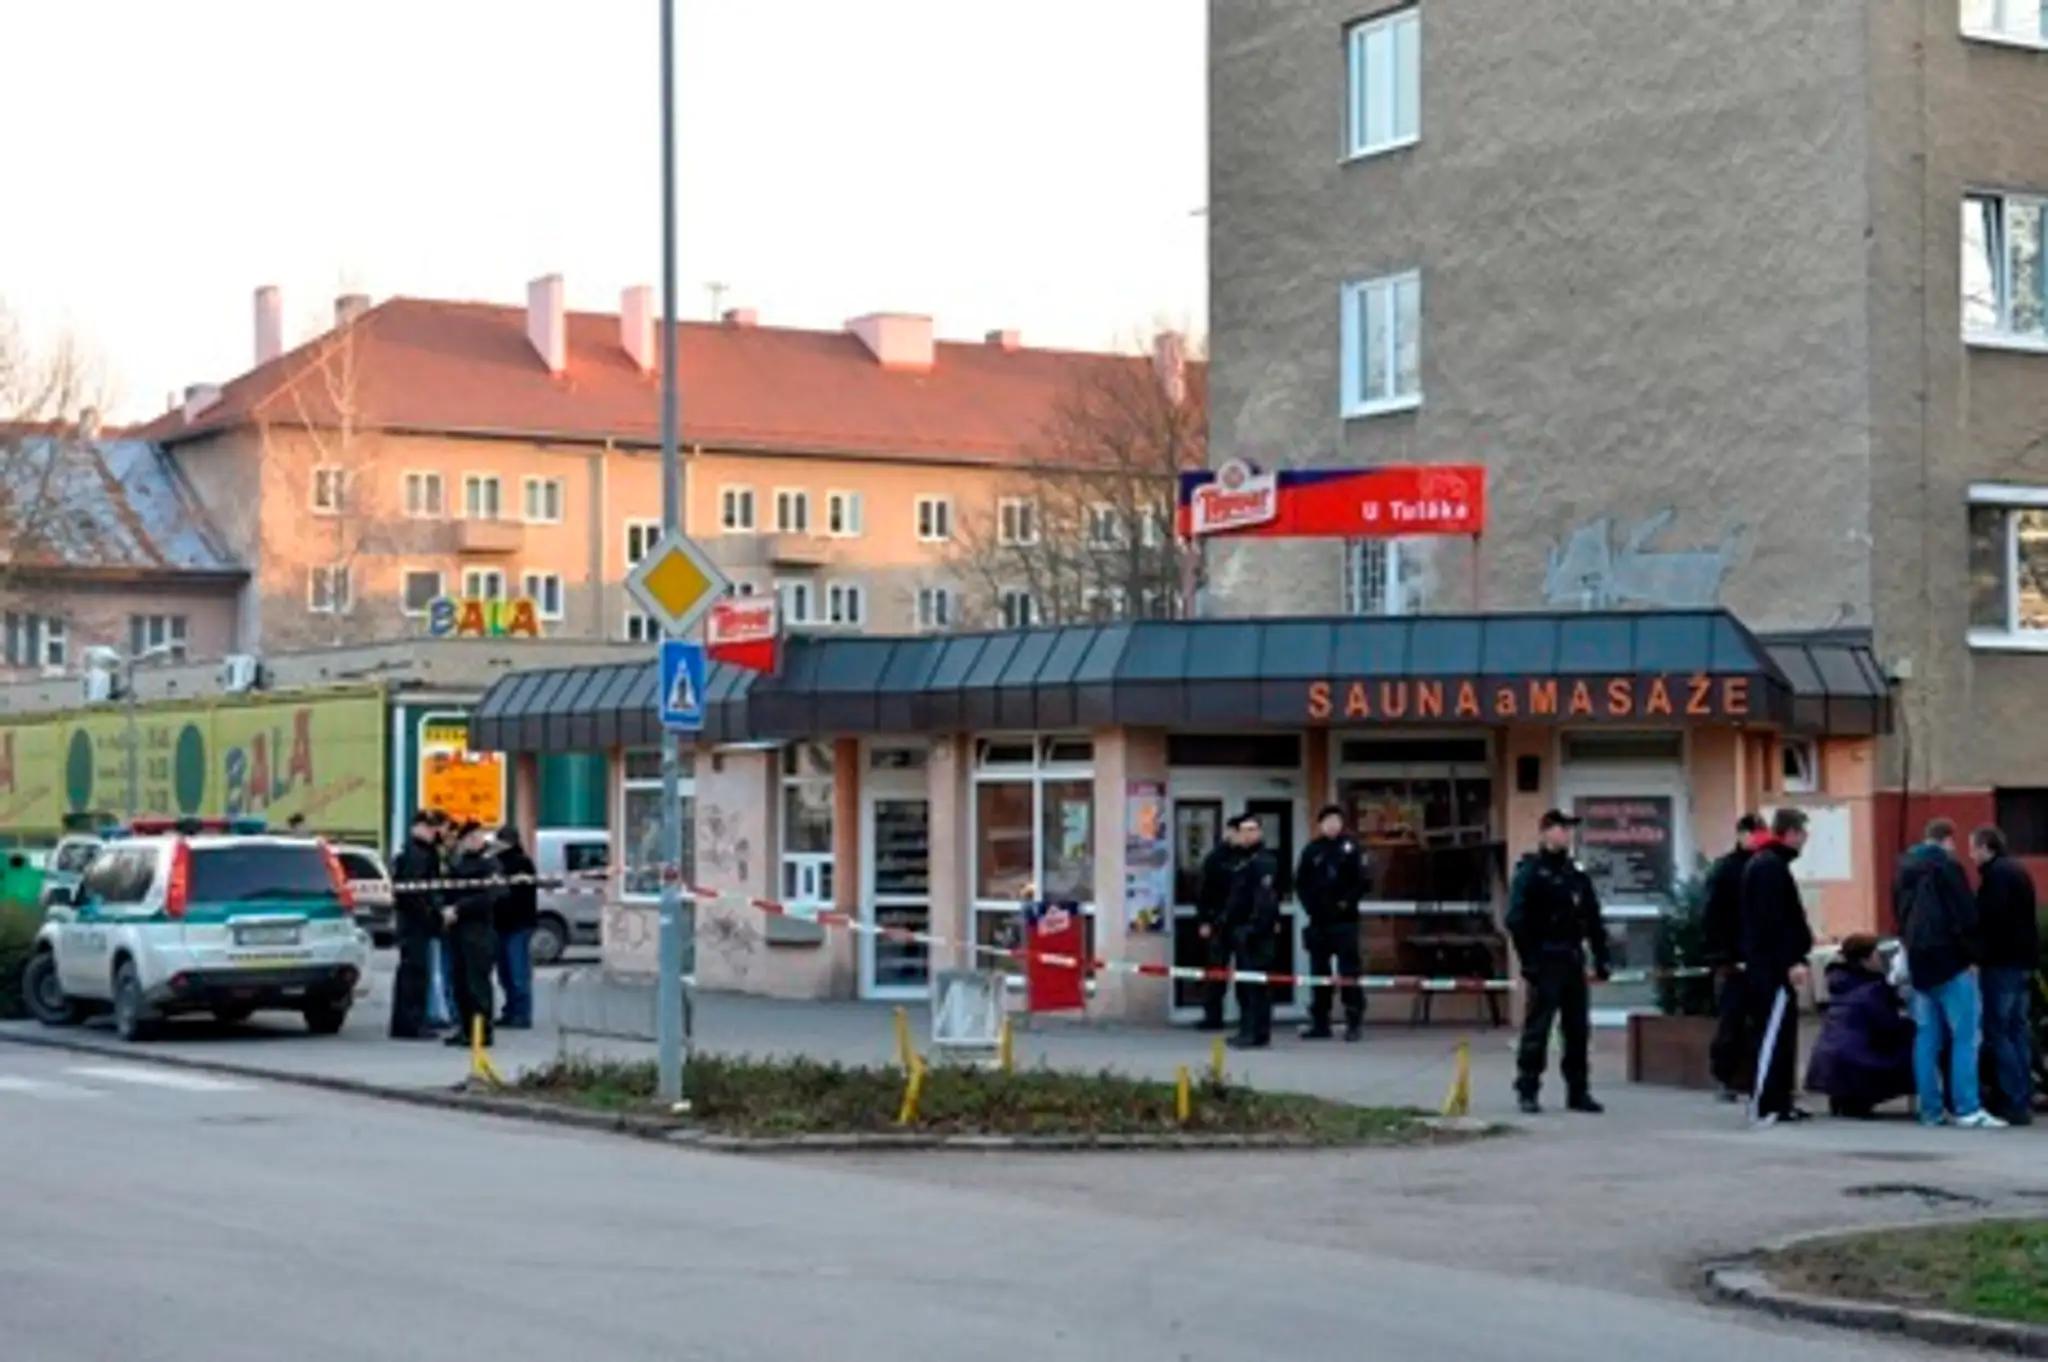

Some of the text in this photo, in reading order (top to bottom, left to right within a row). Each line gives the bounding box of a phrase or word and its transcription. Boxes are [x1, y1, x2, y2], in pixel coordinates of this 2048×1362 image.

[1361, 500, 1379, 520] U
[428, 597, 539, 637] BALA
[1308, 672, 1750, 718] SAUNA a MASÁŽE
[225, 707, 314, 818] BALA
